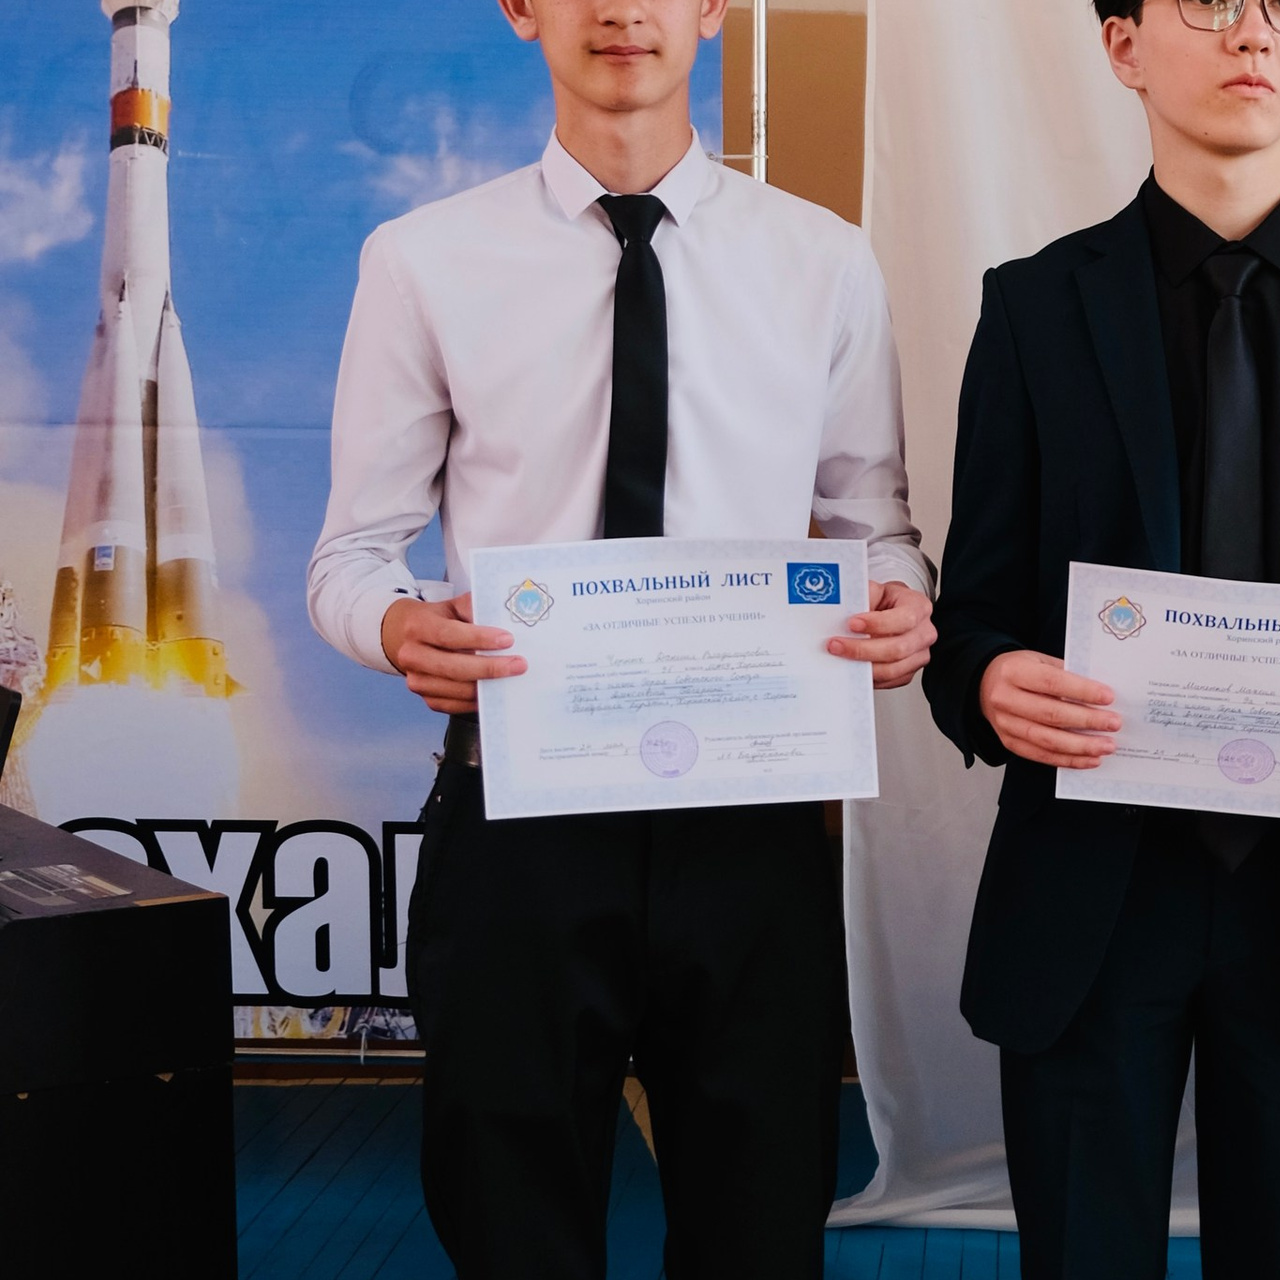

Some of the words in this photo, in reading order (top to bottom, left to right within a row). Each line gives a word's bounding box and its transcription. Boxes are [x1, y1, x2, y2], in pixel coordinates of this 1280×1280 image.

[572, 570, 711, 596] ПОХВАЛЬНЫЙ
[721, 573, 773, 587] ЛИСТ
[603, 618, 660, 631] ОТЛИЧНЫЕ
[664, 615, 706, 626] УСПЕХИ
[709, 614, 716, 623] В
[1190, 651, 1247, 663] ОТЛИЧНЫЕ
